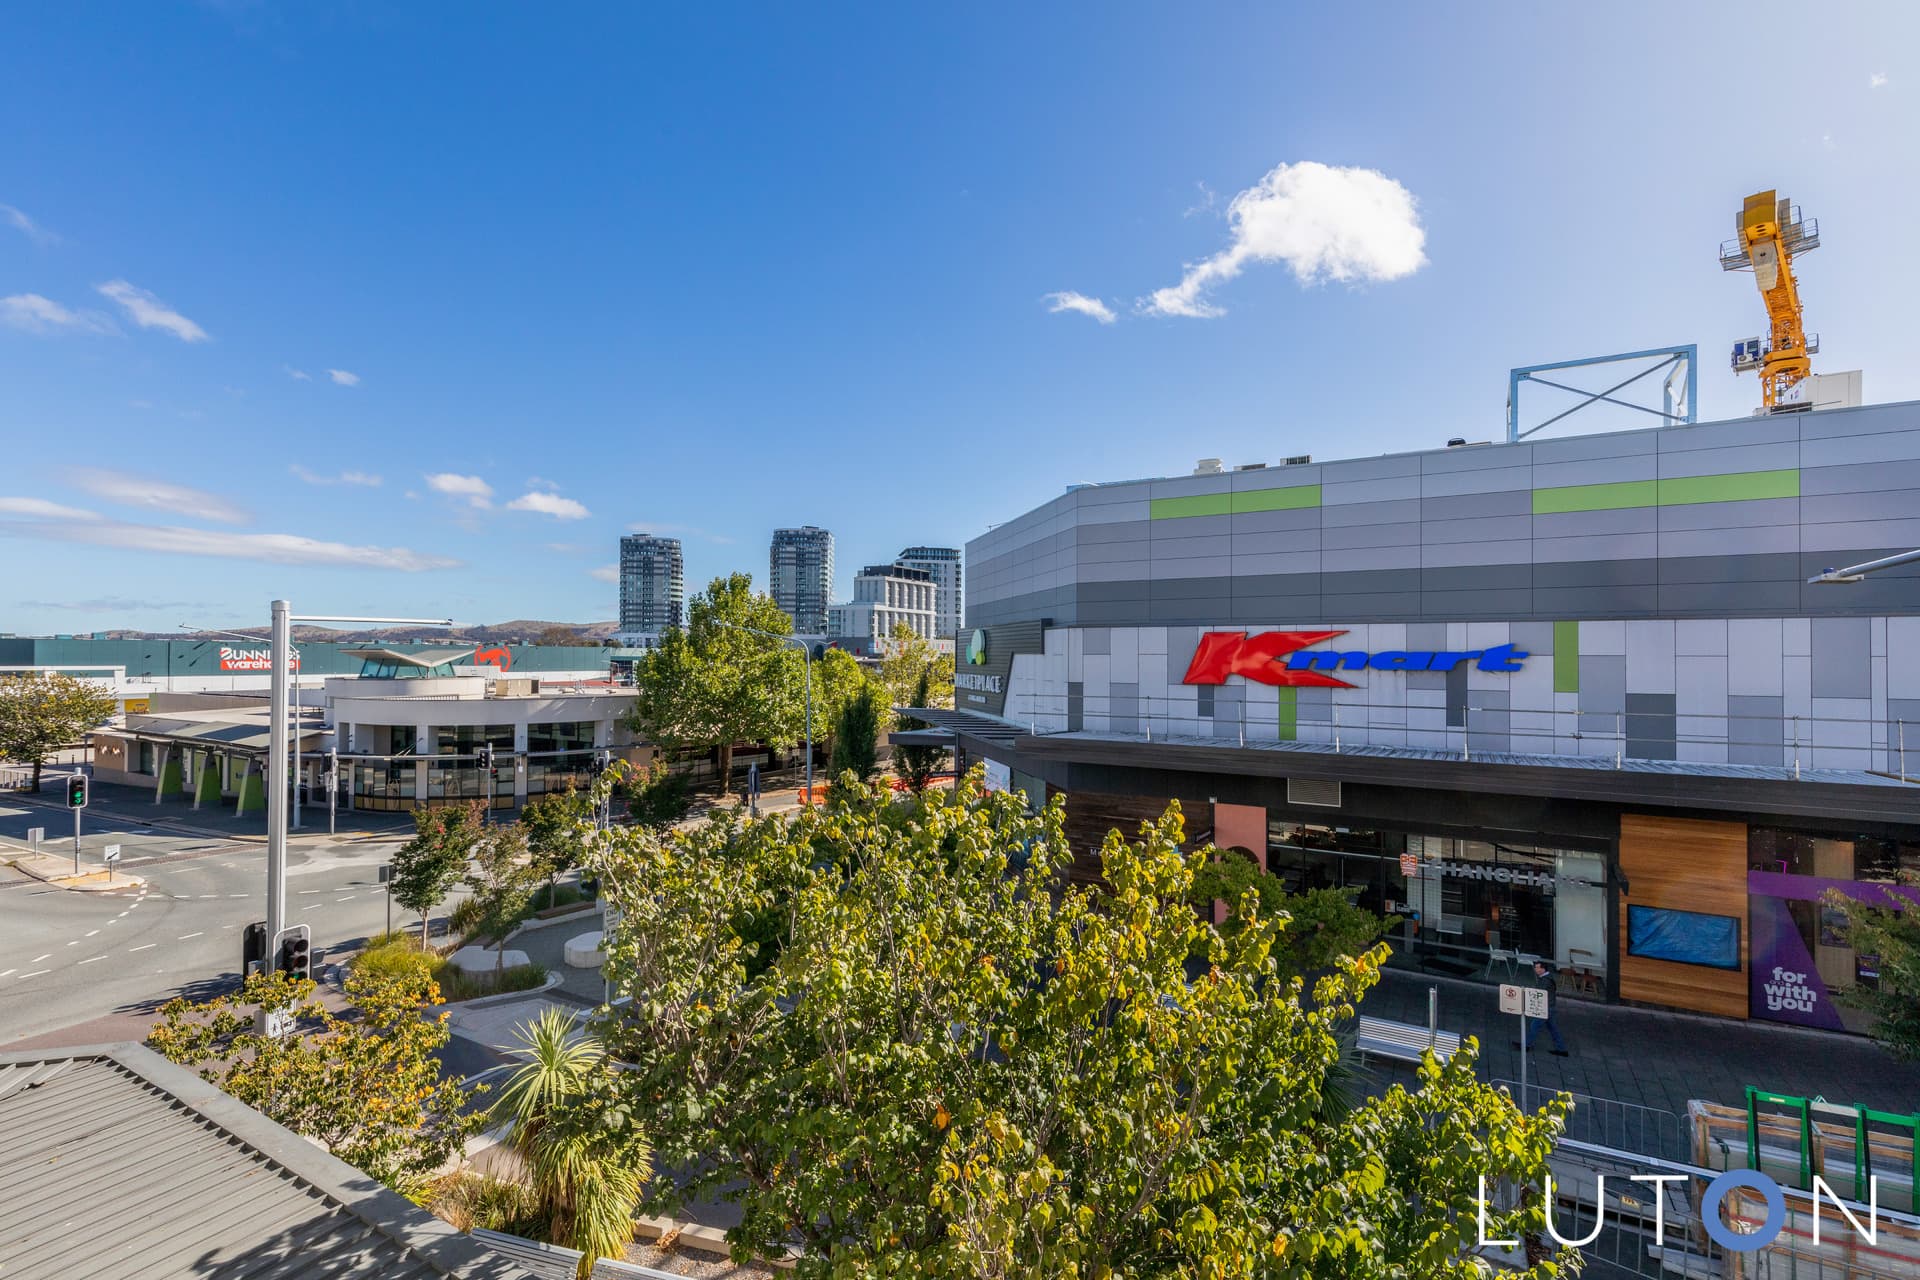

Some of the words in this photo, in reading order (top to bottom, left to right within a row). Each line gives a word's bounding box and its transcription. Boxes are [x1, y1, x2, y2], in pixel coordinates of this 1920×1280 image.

[1183, 630, 1529, 688] Kmart
[1772, 966, 1807, 984] for
[1763, 983, 1817, 1002] with
[1767, 995, 1813, 1013] you
